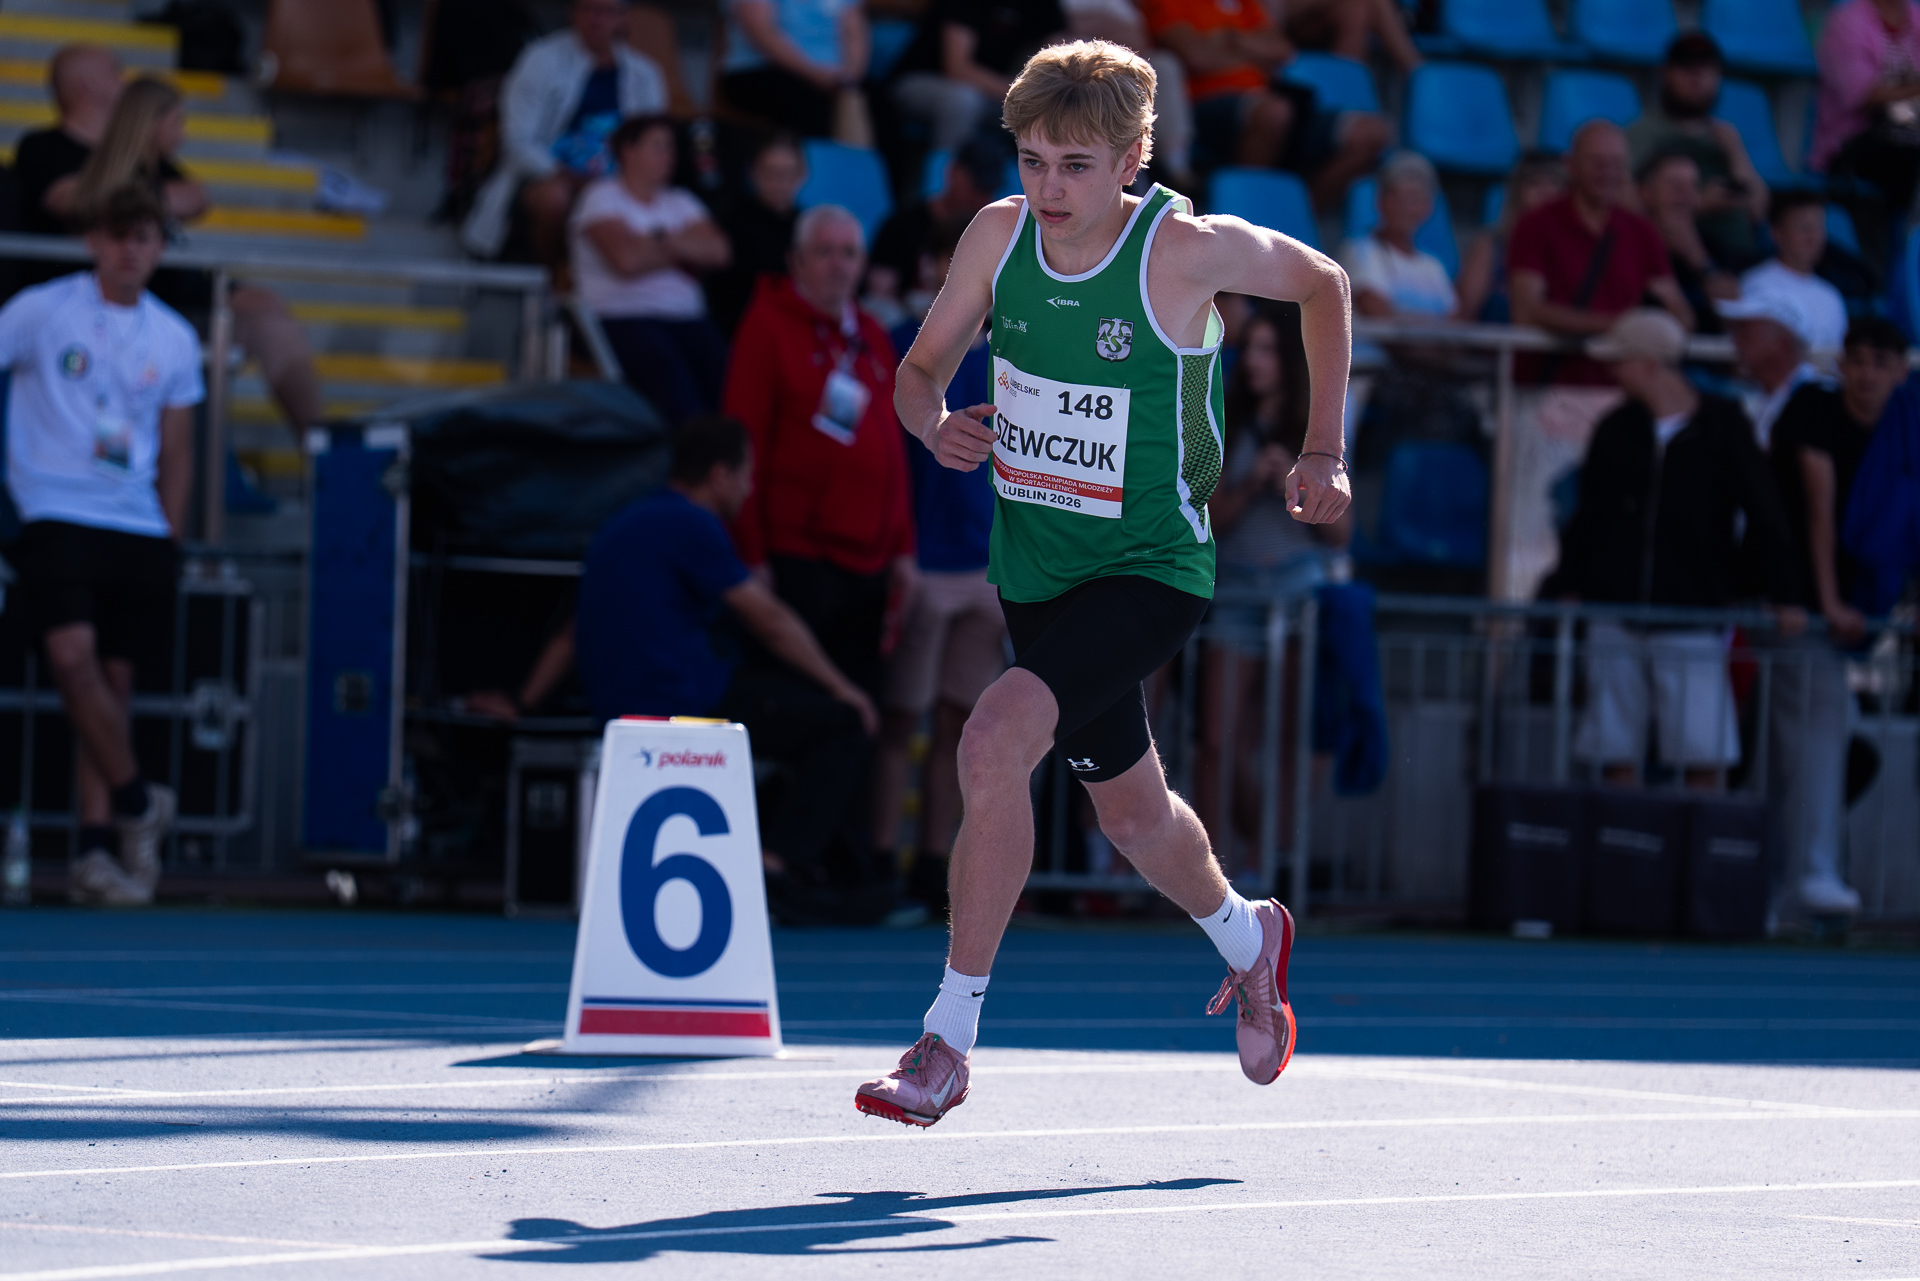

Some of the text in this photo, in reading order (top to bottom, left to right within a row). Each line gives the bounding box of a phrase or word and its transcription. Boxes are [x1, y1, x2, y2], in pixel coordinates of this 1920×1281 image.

[1010, 377, 1040, 396] LUBELSKIE
[1058, 391, 1113, 420] 148
[996, 412, 1117, 472] SZEWCZUK
[1016, 477, 1051, 488] SPORTACH
[1051, 484, 1078, 494] LETNICH
[1043, 475, 1078, 488] OLIMPIADA
[1003, 484, 1081, 508] LUBLIN 2026
[657, 749, 727, 770] polanik
[619, 785, 733, 980] 6
